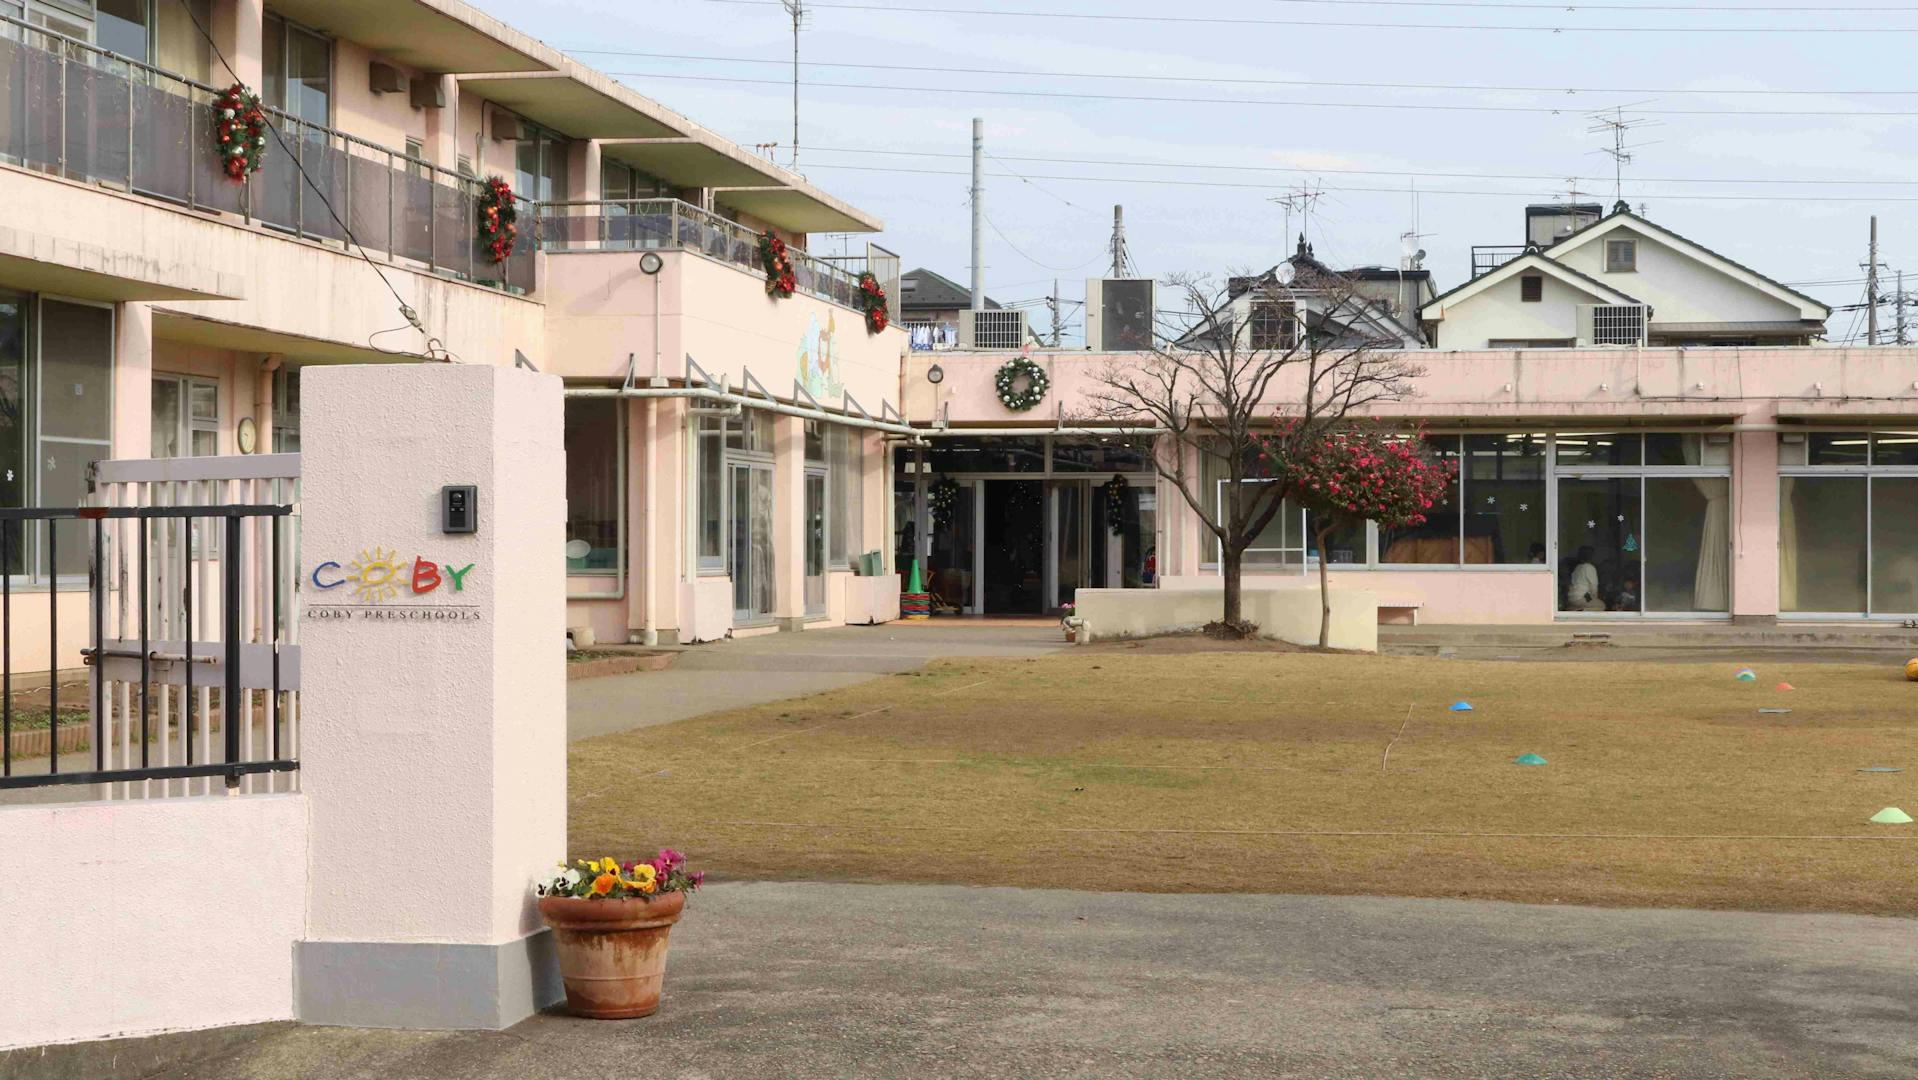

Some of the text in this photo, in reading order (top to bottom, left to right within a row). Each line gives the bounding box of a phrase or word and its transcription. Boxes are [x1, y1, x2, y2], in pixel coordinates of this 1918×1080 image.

[312, 547, 475, 601] COBY
[307, 610, 481, 621] COBY PRESCHOOLS
